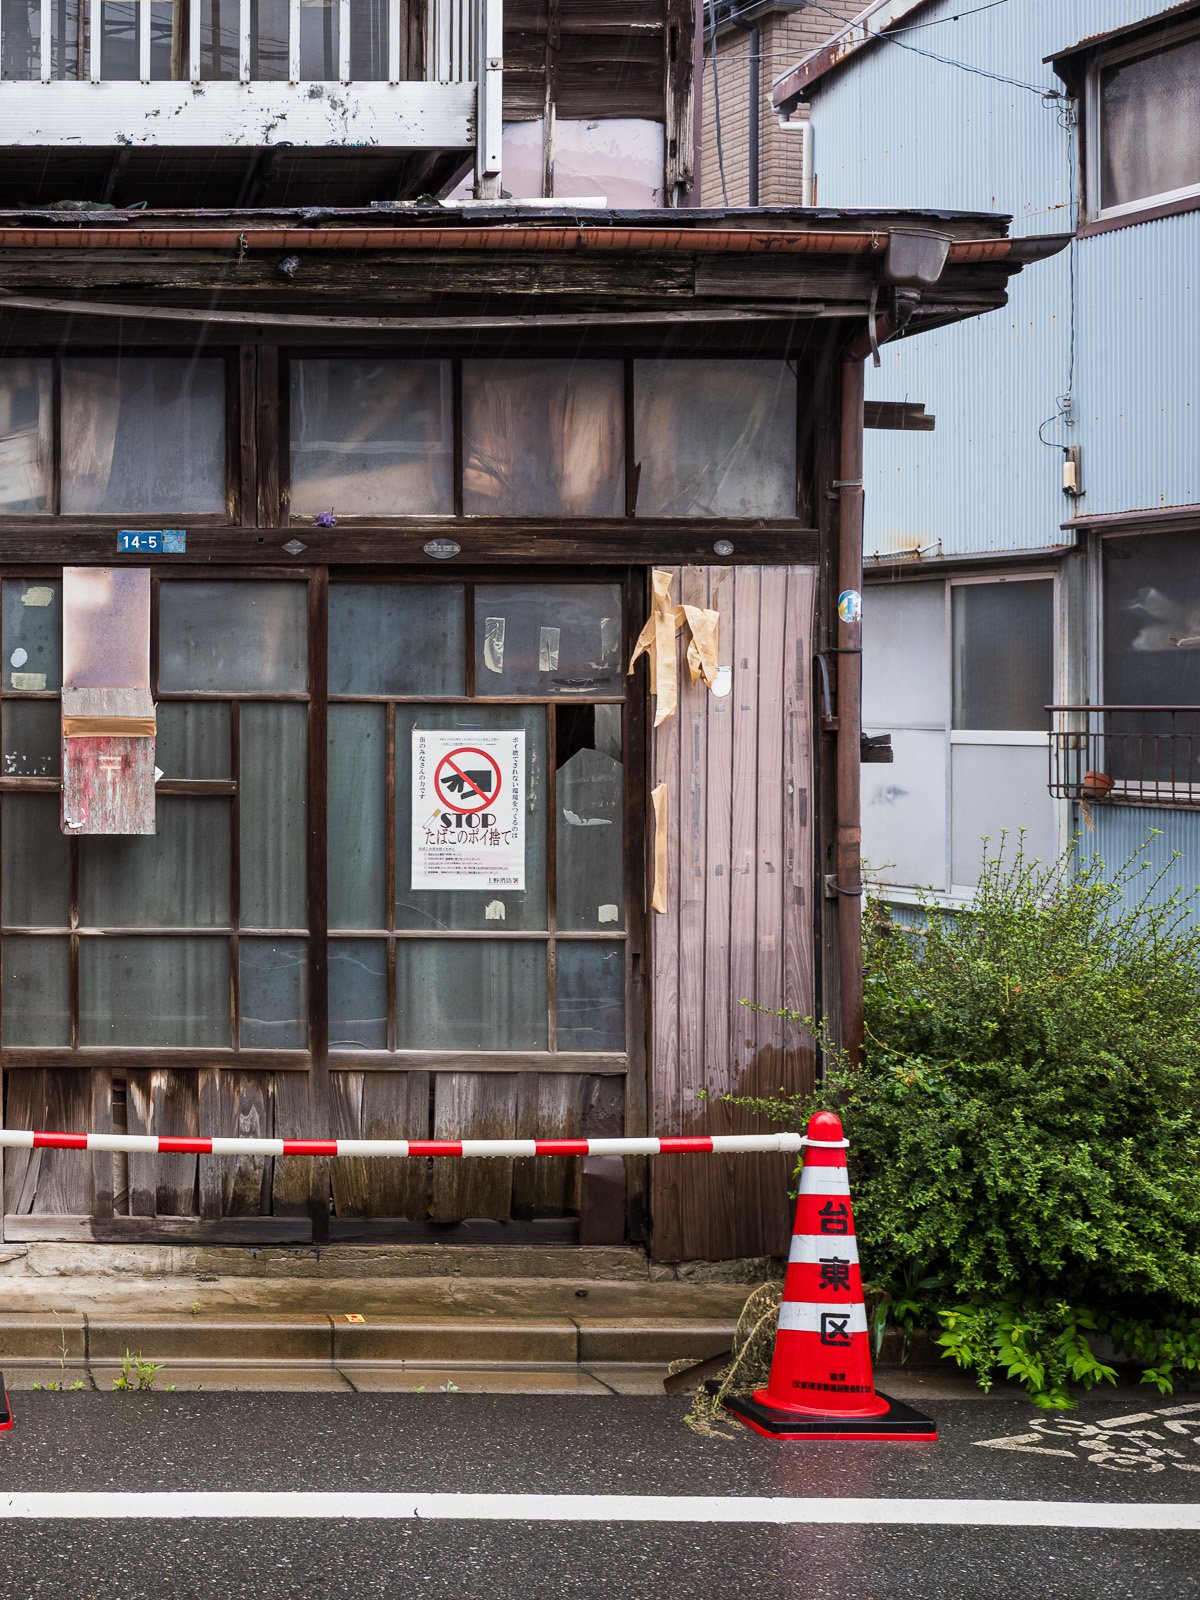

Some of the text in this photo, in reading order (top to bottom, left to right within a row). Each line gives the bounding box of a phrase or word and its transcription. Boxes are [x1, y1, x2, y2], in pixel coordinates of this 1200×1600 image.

[123, 535, 157, 549] 14-5
[440, 812, 497, 828] STOP
[425, 828, 512, 846] たばこのポイ捨て
[817, 1200, 851, 1347] 台東区
